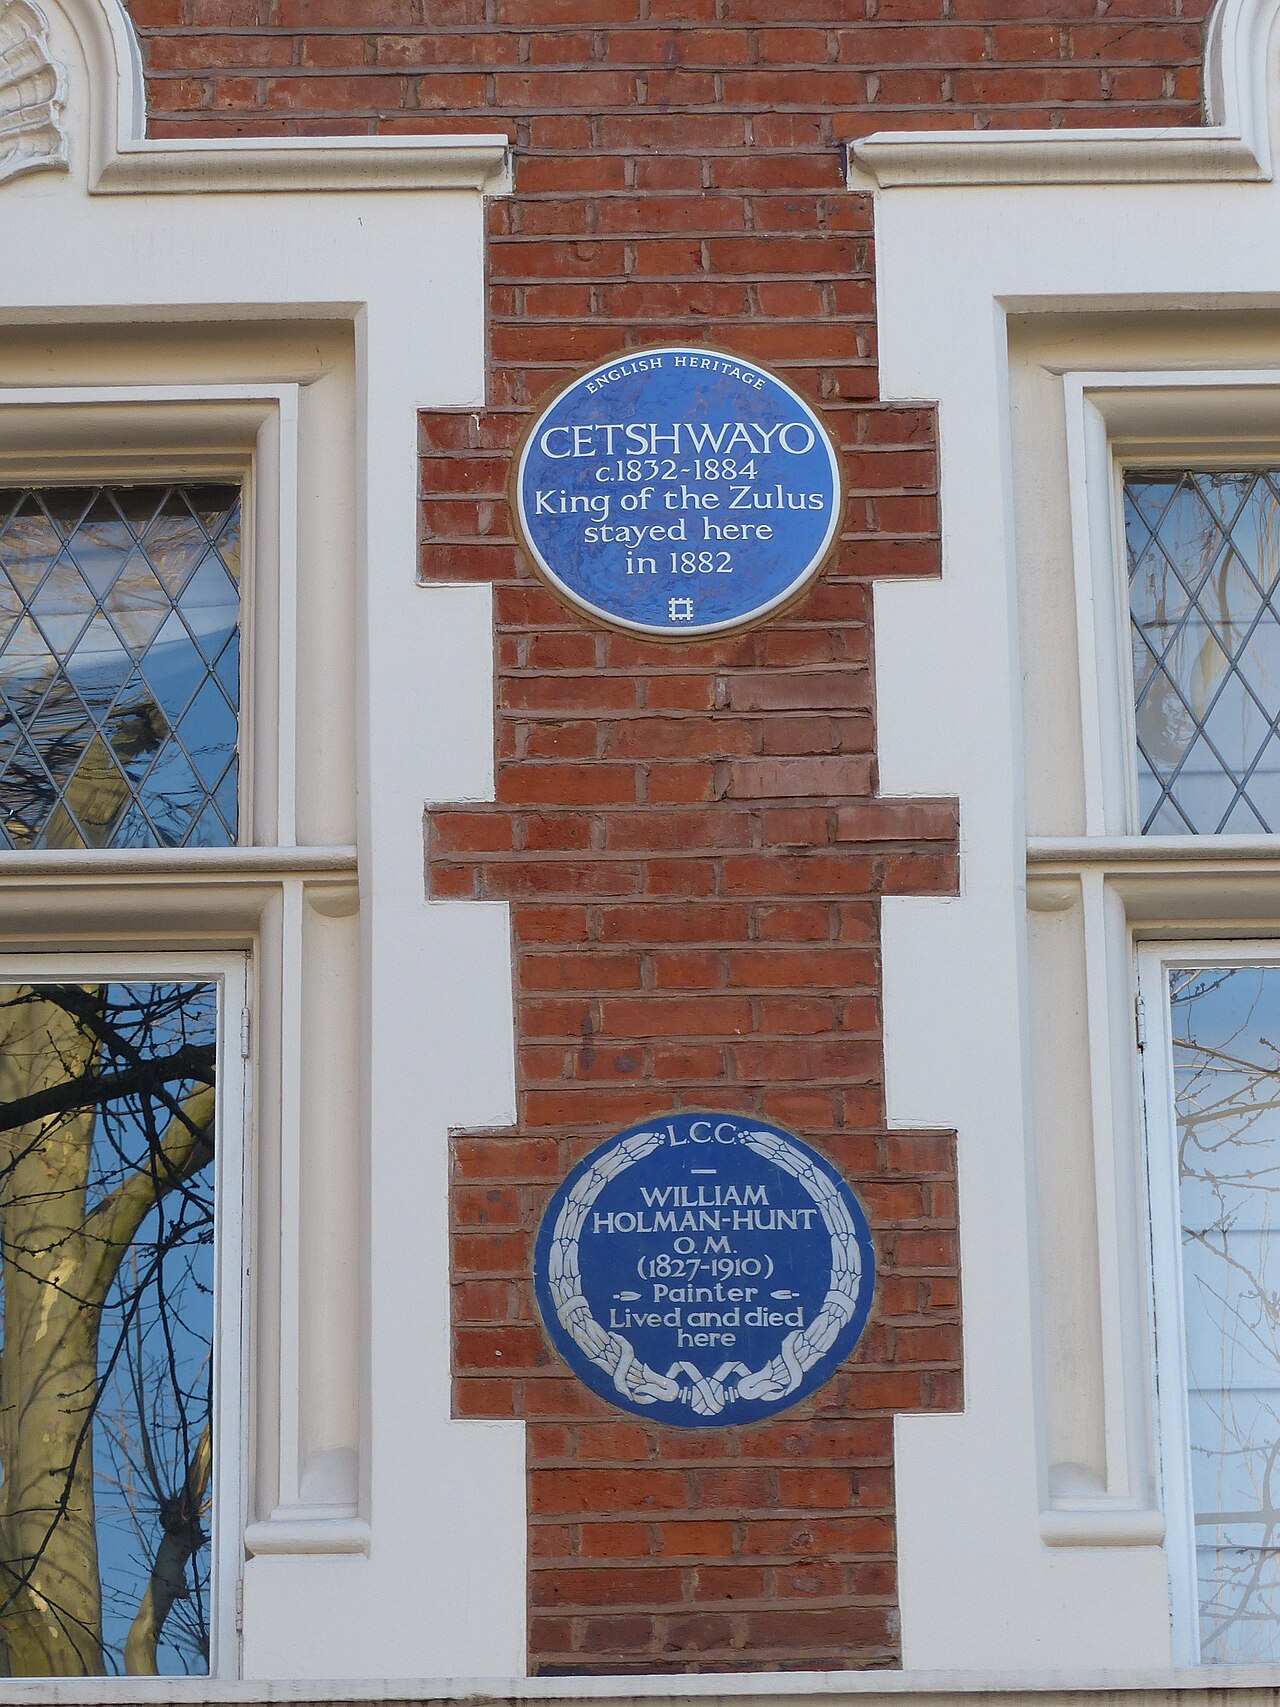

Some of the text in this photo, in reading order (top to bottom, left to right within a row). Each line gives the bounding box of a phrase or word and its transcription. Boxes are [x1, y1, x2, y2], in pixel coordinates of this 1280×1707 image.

[585, 356, 766, 394] ENGLISH HERITAGE
[540, 422, 815, 459] CETSHWAYO
[534, 484, 824, 522] King of the Zulus
[584, 516, 774, 549] stayed here
[626, 551, 734, 575] in 1882
[639, 1185, 770, 1208] WILLIAM
[592, 1209, 818, 1234] HOLMAN-HUNT
[637, 1254, 774, 1281] (1827-1910)
[653, 1282, 758, 1303] Painter
[609, 1306, 804, 1328] Lived and died
[677, 1328, 736, 1347] here
